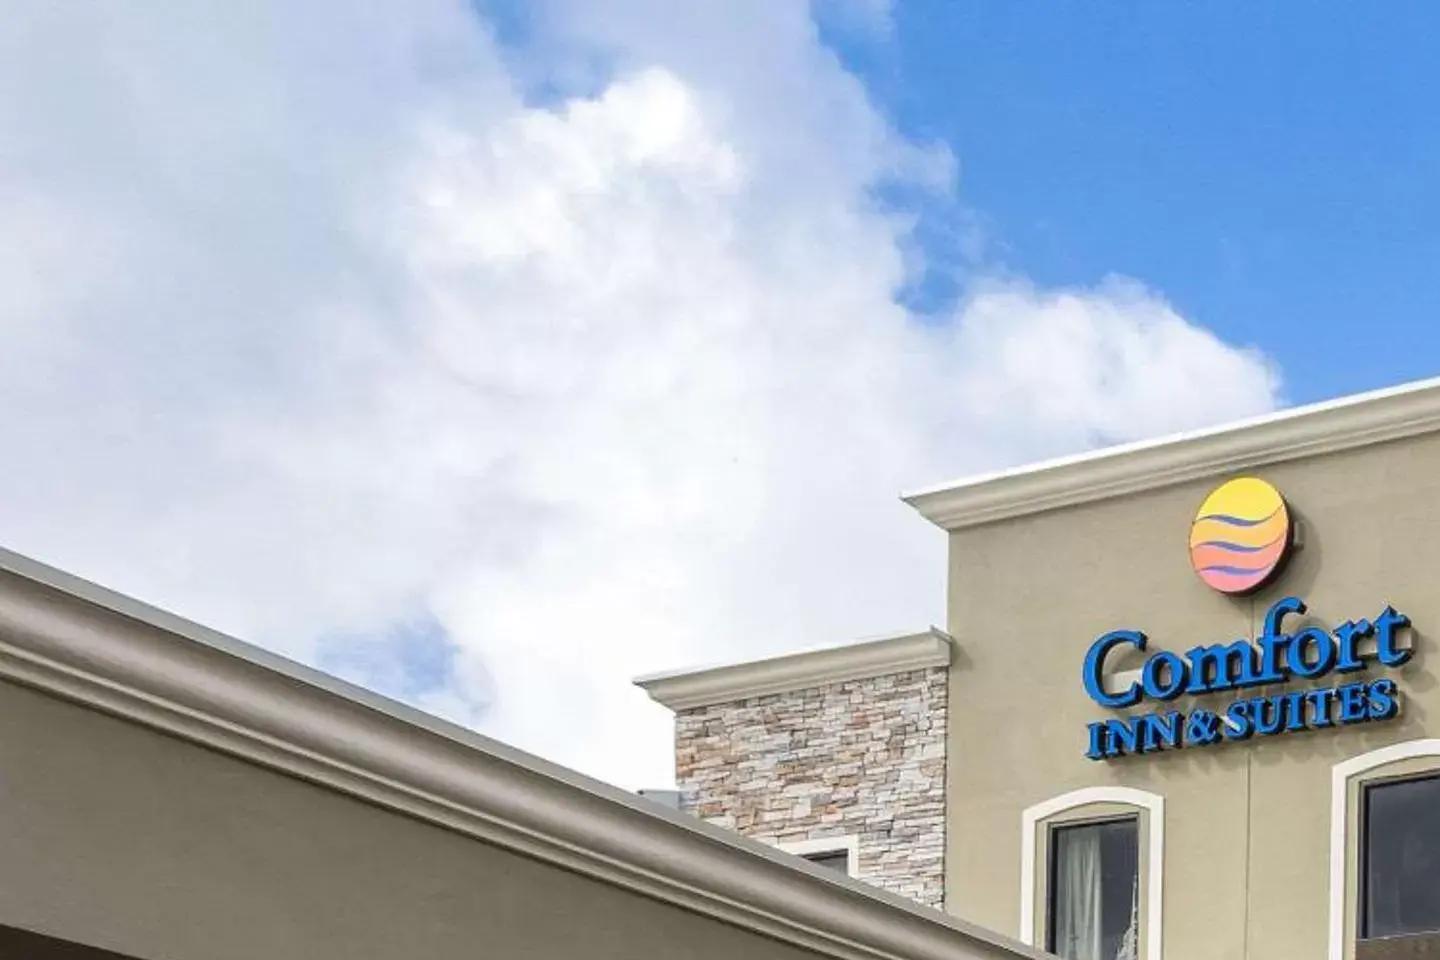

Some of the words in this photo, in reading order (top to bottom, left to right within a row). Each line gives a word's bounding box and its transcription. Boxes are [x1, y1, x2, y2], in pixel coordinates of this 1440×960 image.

[1083, 597, 1413, 708] Comfort
[1085, 712, 1182, 760] INN
[1187, 710, 1221, 745] &
[1224, 679, 1398, 738] SUITES
